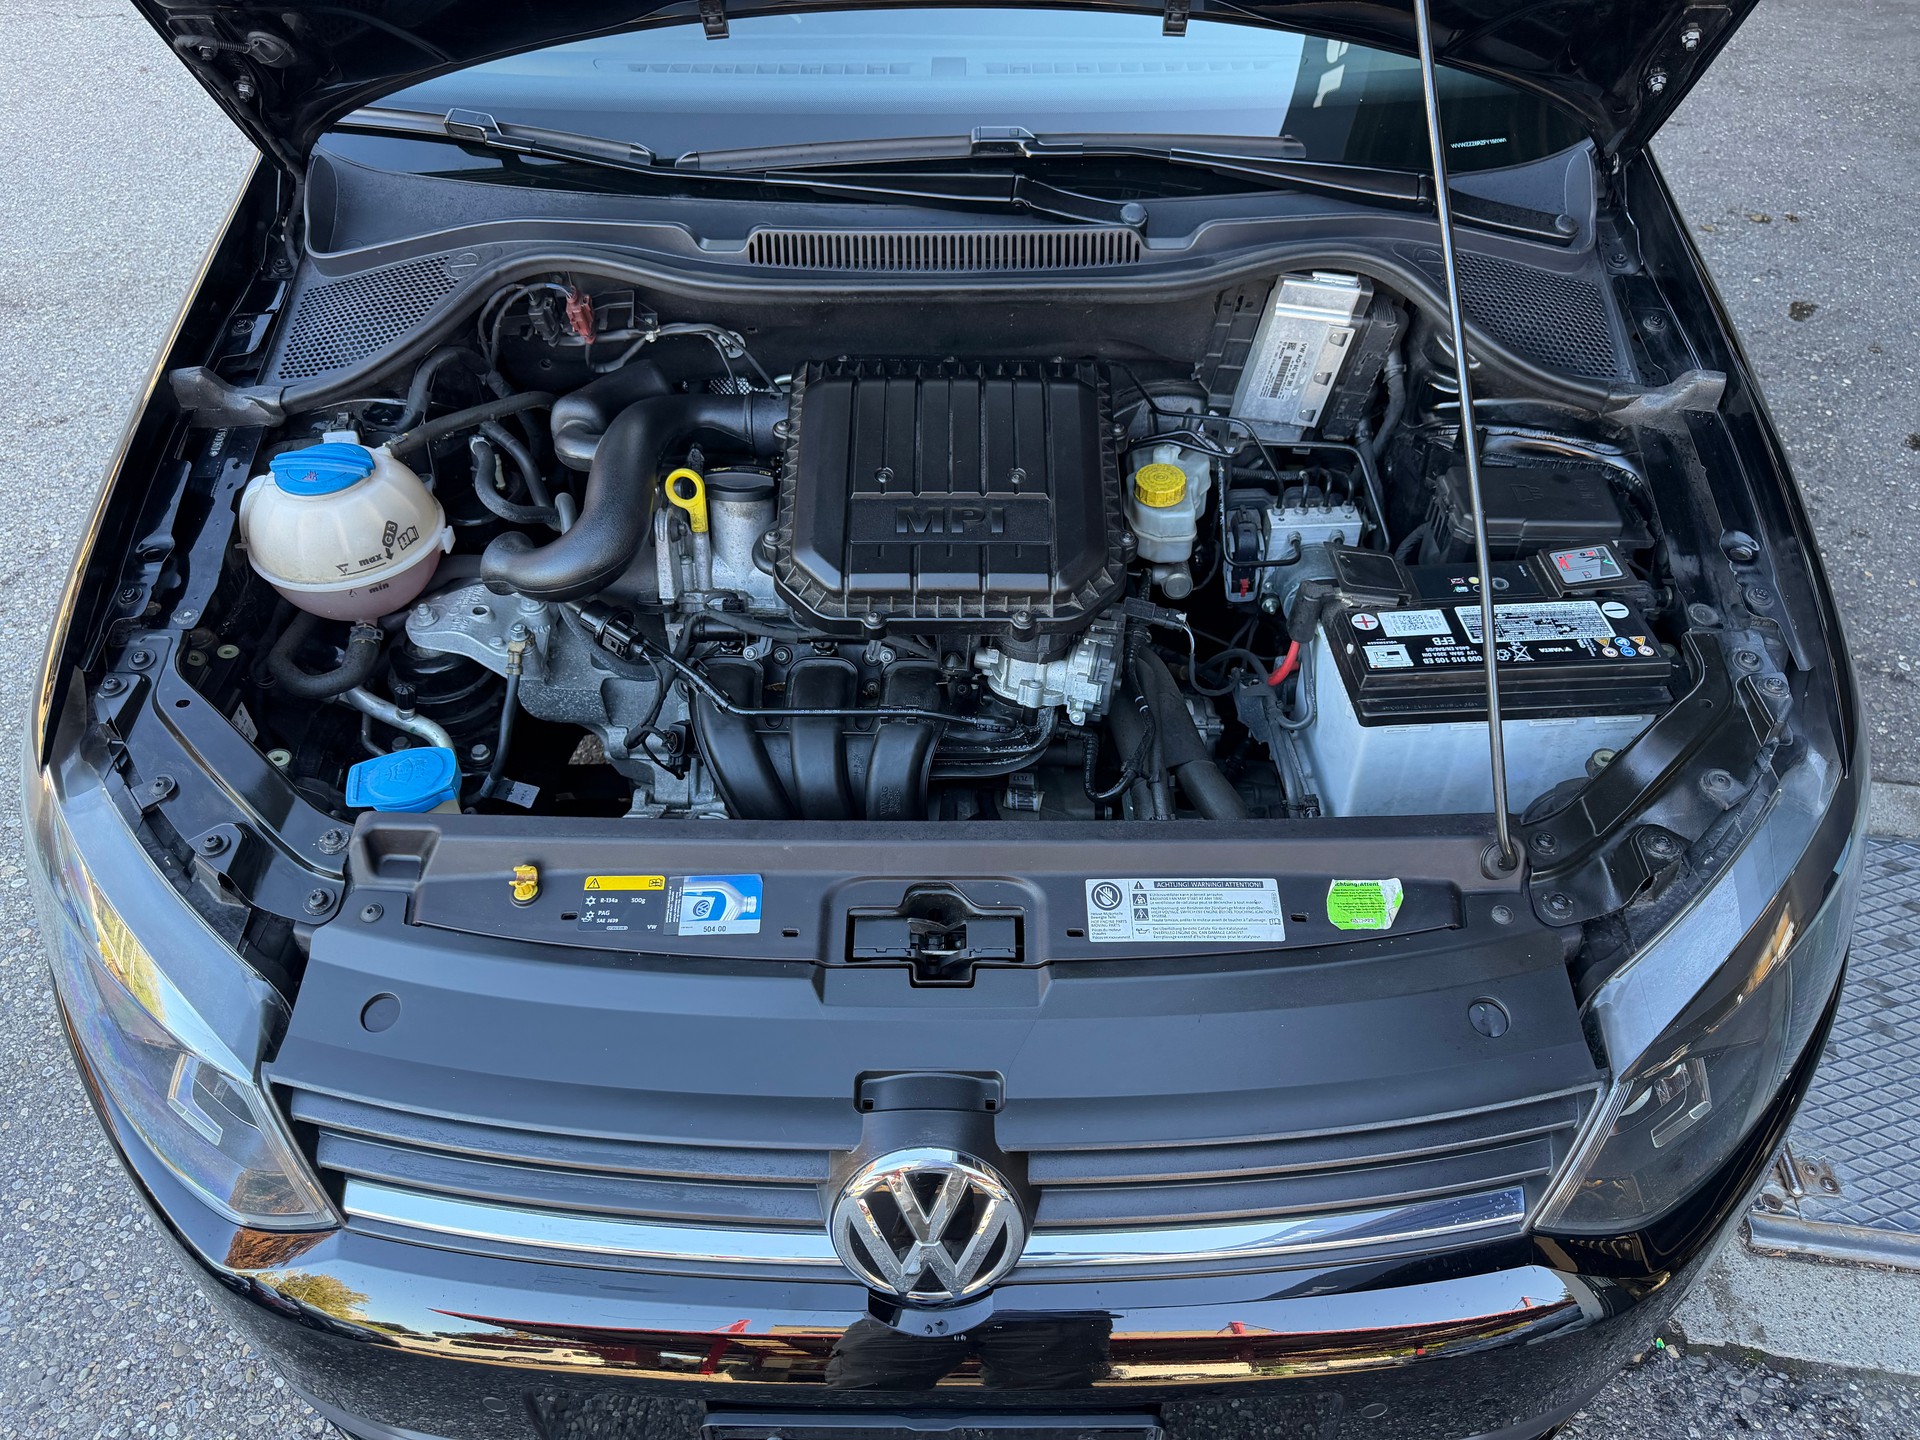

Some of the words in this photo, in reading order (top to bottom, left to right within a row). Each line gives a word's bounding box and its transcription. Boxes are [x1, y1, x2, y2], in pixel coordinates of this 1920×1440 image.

[896, 507, 1004, 533] MPI
[384, 523, 397, 544] G13
[358, 553, 383, 566] max
[369, 582, 389, 593] min
[1432, 636, 1456, 645] EFB
